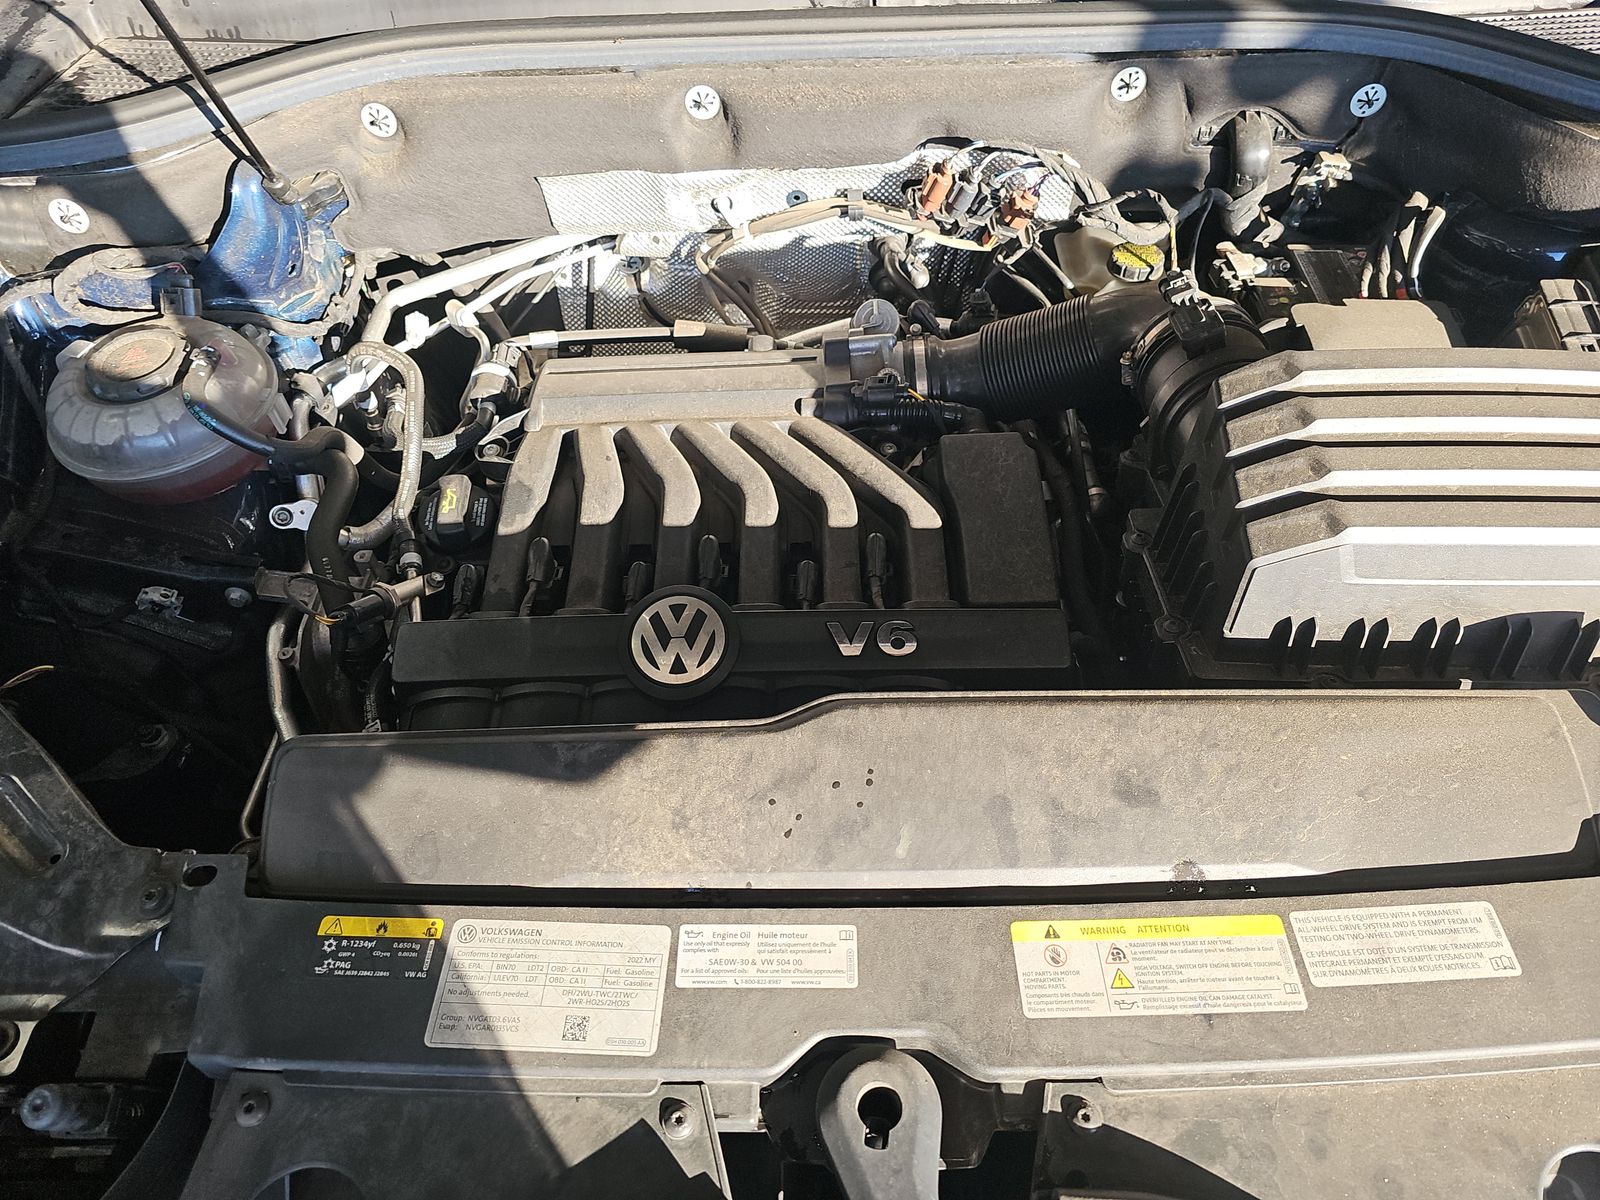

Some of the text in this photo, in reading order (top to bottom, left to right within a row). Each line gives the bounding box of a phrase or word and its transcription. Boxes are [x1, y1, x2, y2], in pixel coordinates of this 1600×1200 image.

[826, 620, 918, 657] V6
[1311, 915, 1342, 923] VEHICLE
[1353, 912, 1389, 922] EQUIPPED
[1418, 909, 1463, 917] PERMANENT
[480, 927, 543, 937] VOLKSWAGEN
[1080, 924, 1190, 935] WARNING ATTENTION
[1298, 925, 1338, 933] ALL-WHEEL
[1363, 922, 1390, 930] SYSTEM
[712, 932, 738, 940] Engine
[1346, 932, 1393, 940] TWO-WHEEL
[341, 940, 376, 949] R-1234yf
[508, 937, 540, 946] EMISSION
[542, 938, 573, 946] CONTROL
[575, 939, 624, 948] INFORMATION
[1451, 941, 1503, 950] TRANSMISSION
[500, 951, 540, 960] regulations:
[1347, 957, 1392, 966] PERMANENT
[1397, 965, 1418, 974] DEUX
[1419, 964, 1443, 972] ROUES
[451, 972, 486, 980] California:
[458, 990, 501, 998] adjustments
[441, 1014, 464, 1022] Group:
[438, 1023, 458, 1031] Evap:
